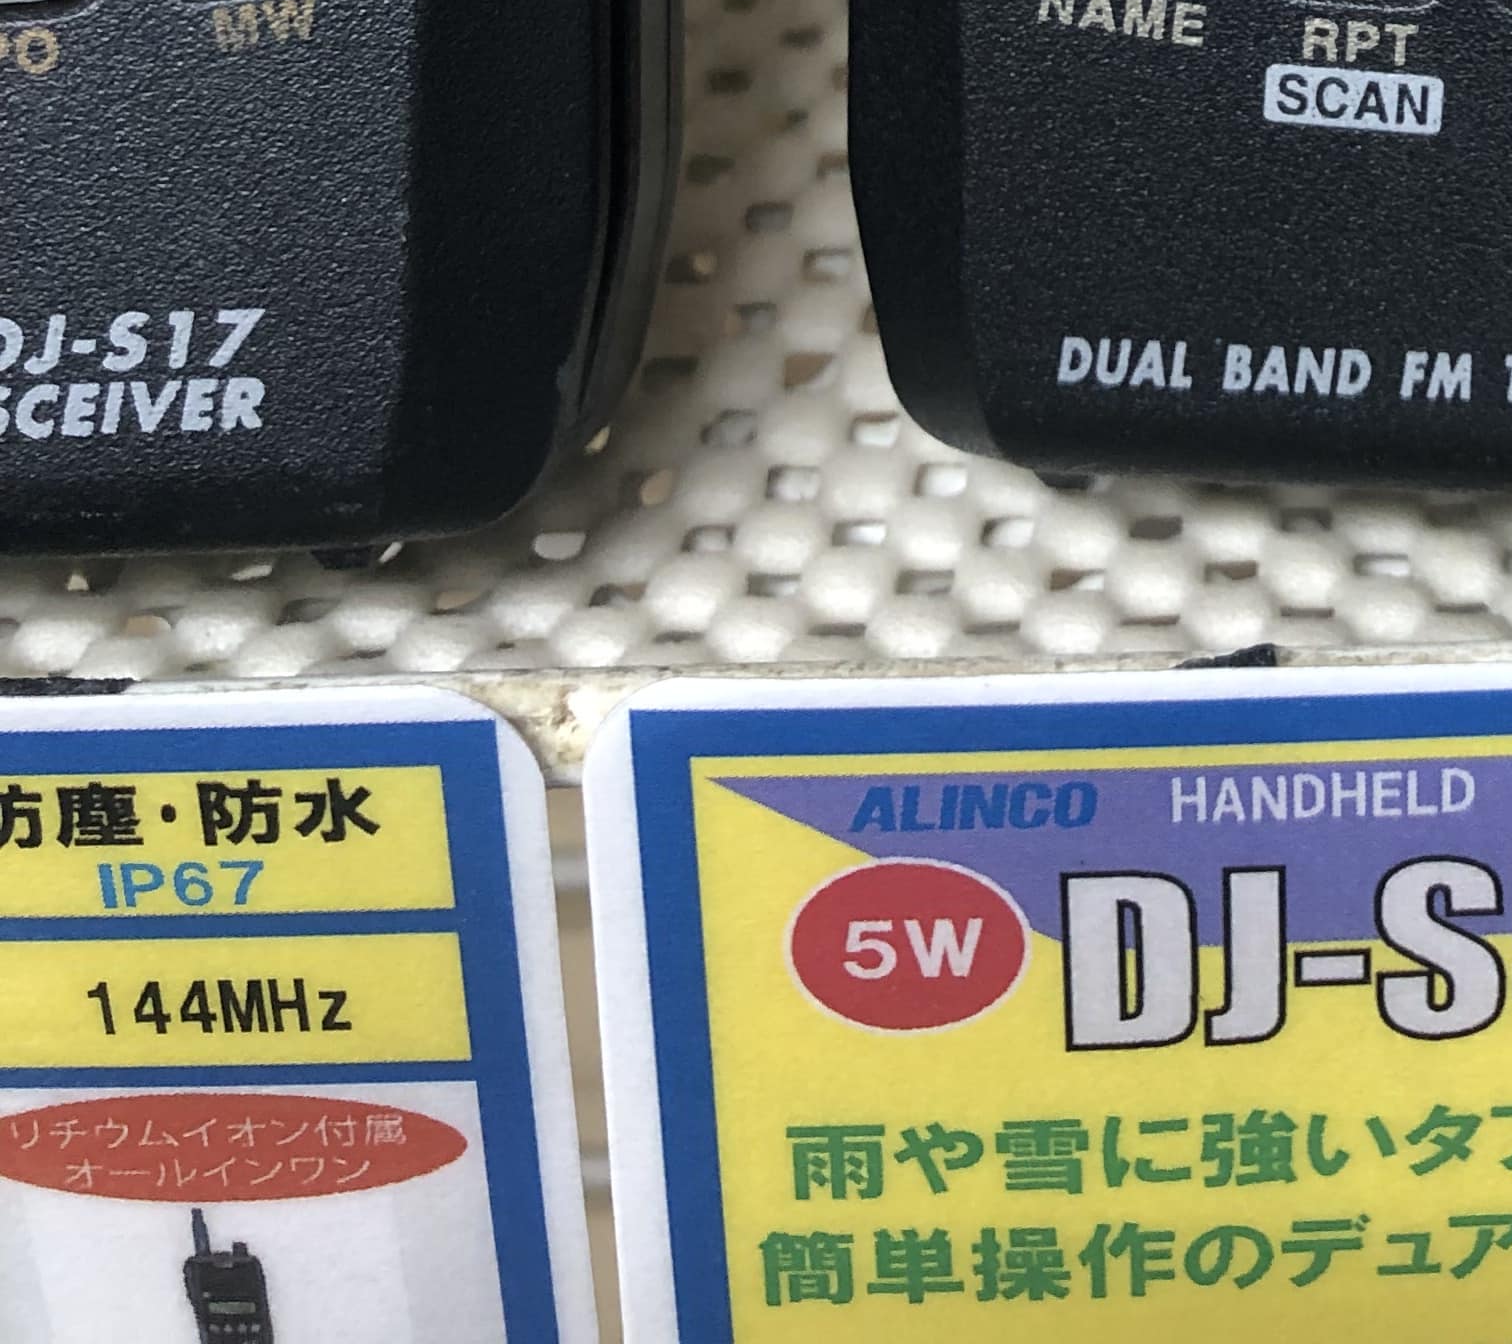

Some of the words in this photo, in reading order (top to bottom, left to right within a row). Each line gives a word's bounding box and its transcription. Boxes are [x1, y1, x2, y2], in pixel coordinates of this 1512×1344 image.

[0, 26, 60, 75] O
[1302, 18, 1418, 65] RPT
[1276, 75, 1431, 125] SCAN
[0, 308, 266, 375] DJ-S17
[1058, 335, 1193, 389] DUAL
[1222, 343, 1372, 399] BAND
[1401, 350, 1473, 402] FM
[849, 781, 1099, 833] ALINCO
[1171, 768, 1476, 824] HANDHELD
[97, 860, 264, 909] IP67
[843, 918, 984, 979] 5W
[87, 978, 353, 1036] 144MHz
[10, 1113, 407, 1150] リチウムイオン付属
[65, 1155, 371, 1188] オールインワン
